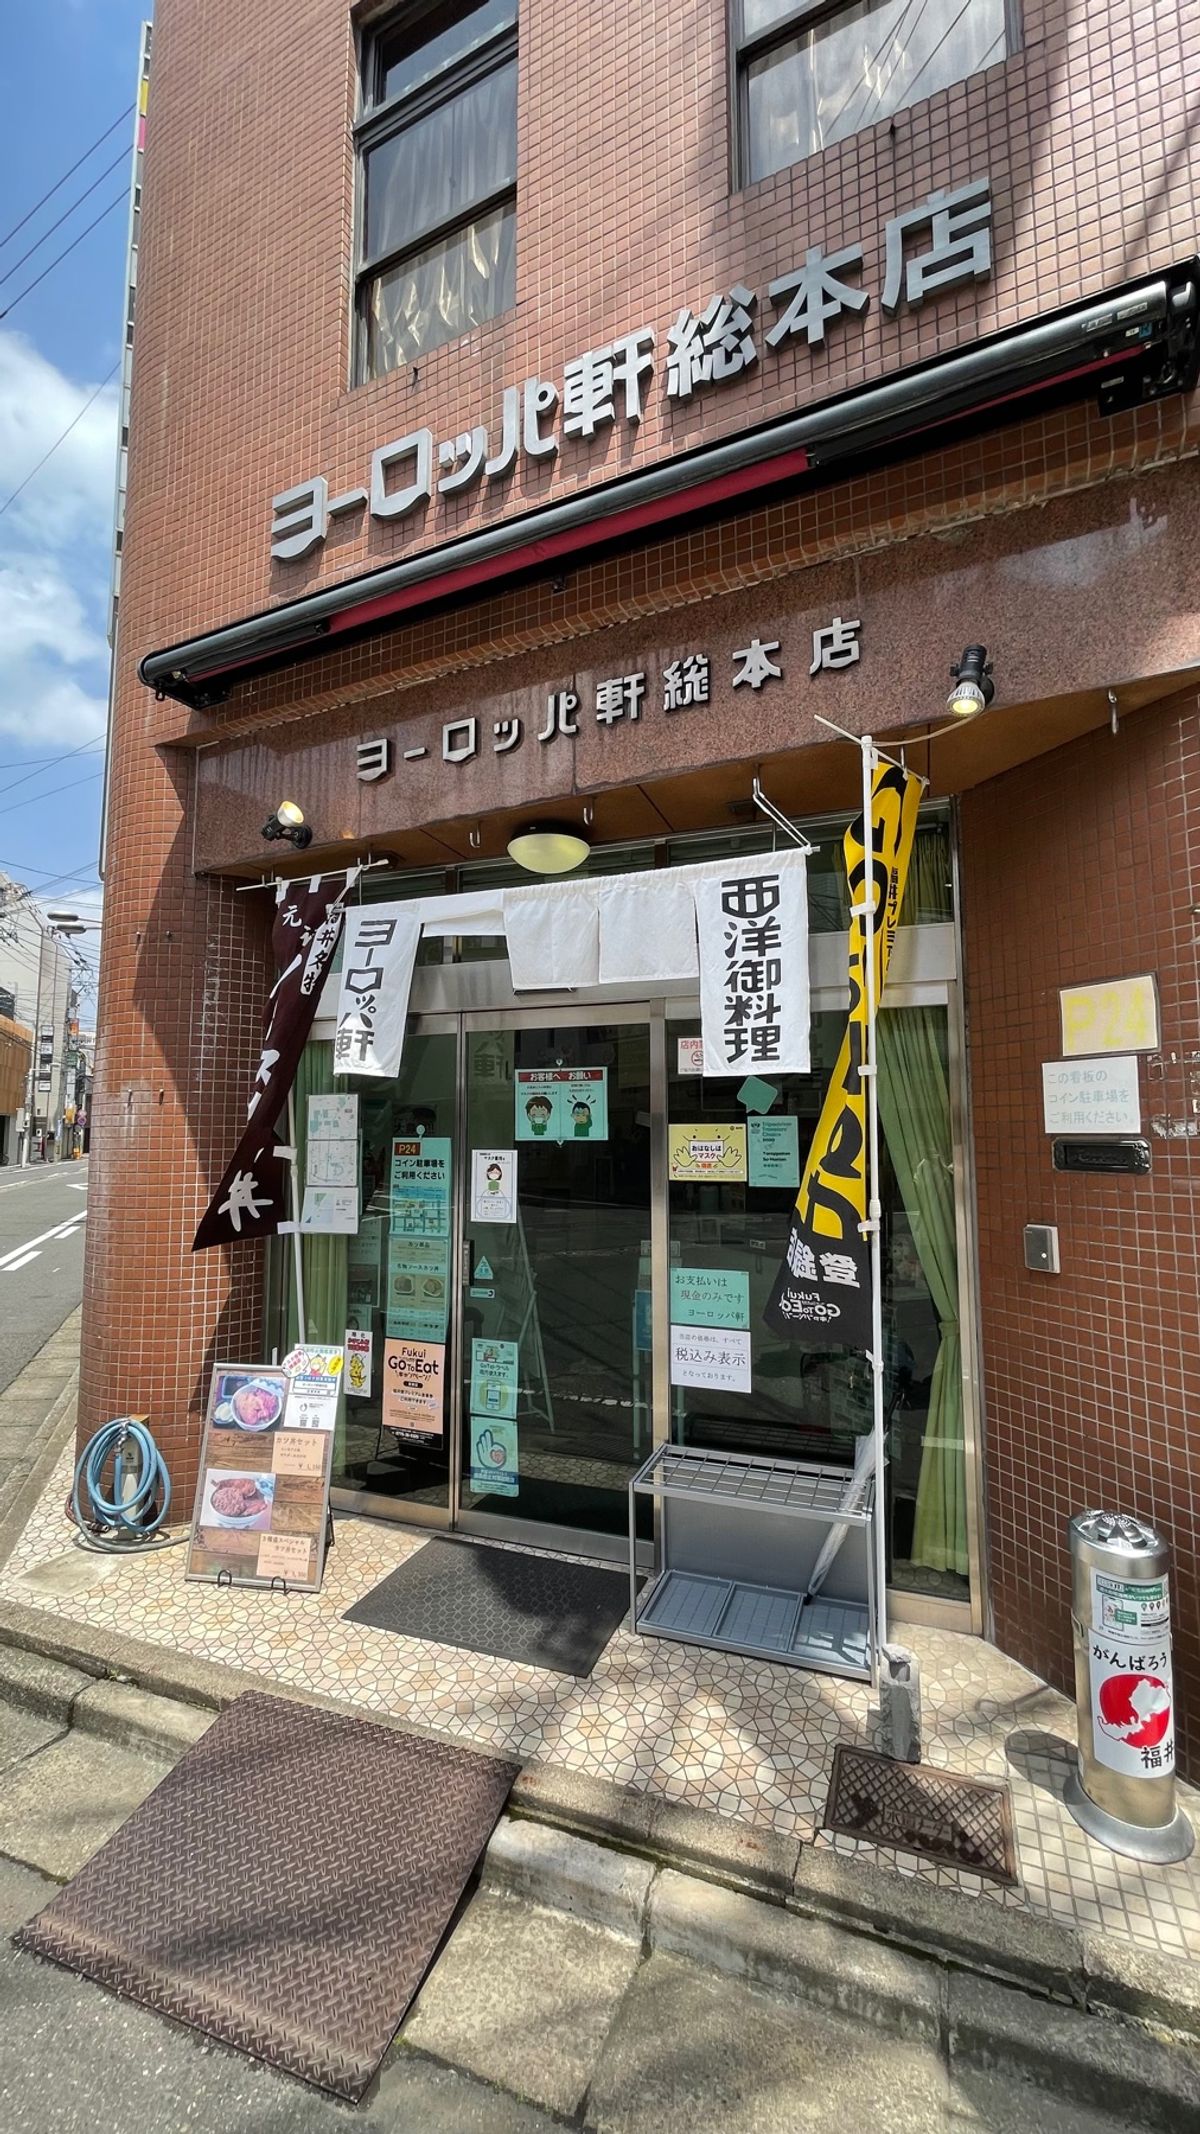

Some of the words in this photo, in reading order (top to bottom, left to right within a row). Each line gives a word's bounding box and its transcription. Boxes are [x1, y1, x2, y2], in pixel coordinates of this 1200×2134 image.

[271, 177, 991, 560] ヨーロッパ軒総本店
[356, 616, 862, 781] ヨーロッパ軒総本店
[721, 874, 782, 1064] 西洋御料理
[1065, 984, 1147, 1050] P24
[1048, 1070, 1108, 1084] この看板の
[1048, 1089, 1129, 1104] コイン駐車場を
[398, 1144, 416, 1154] P24
[394, 1158, 445, 1169] コイン駐車場を
[394, 1170, 445, 1180] ご利用ください
[675, 1275, 728, 1287] お支払いは
[680, 1289, 745, 1305] 現金のみです
[688, 1308, 744, 1323] ヨーロッパ軒
[401, 1346, 426, 1359] Fukui
[674, 1346, 747, 1367] 税込み表示
[415, 1358, 439, 1375] Eat
[1092, 1644, 1168, 1672] がんばろう
[1141, 1740, 1176, 1770] 福井
